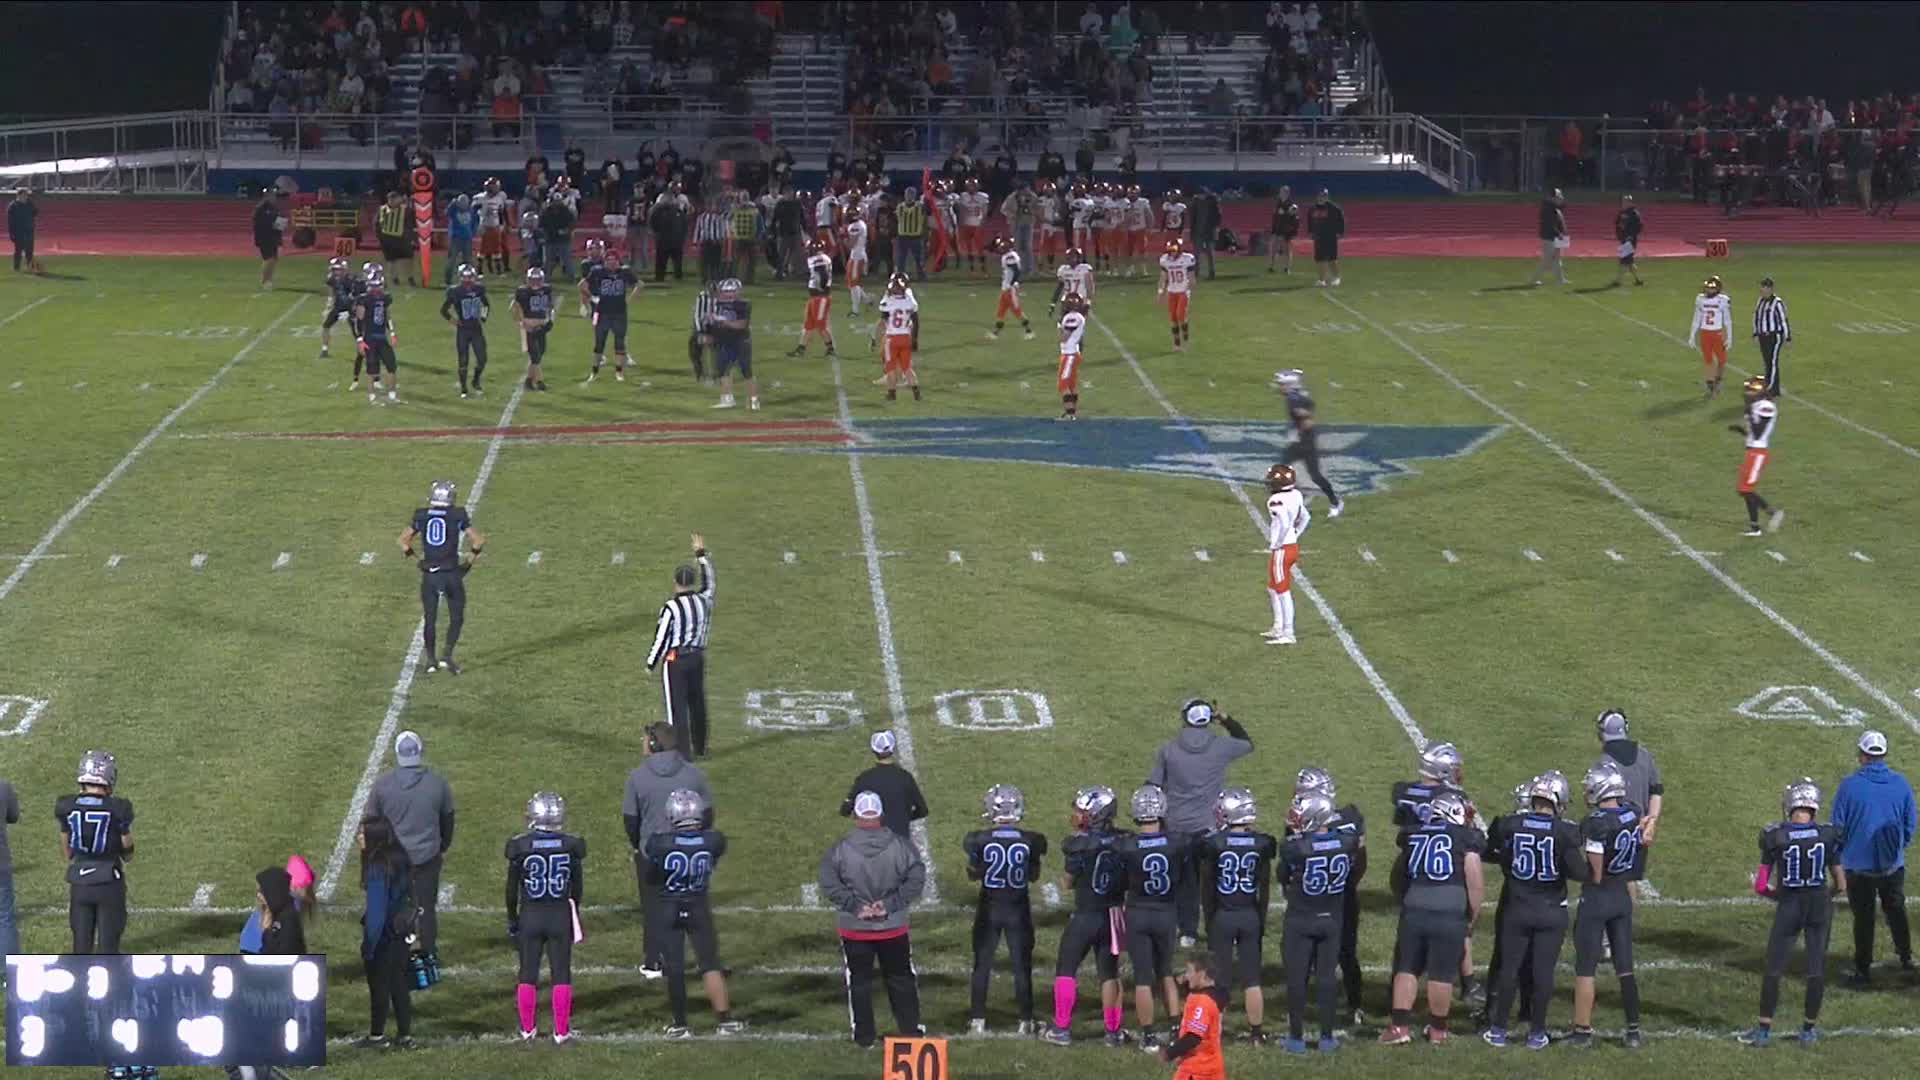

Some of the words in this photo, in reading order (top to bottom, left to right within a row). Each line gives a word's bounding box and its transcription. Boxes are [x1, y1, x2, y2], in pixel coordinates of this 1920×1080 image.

[1710, 241, 1727, 257] 30
[1705, 310, 1715, 326] 2
[426, 517, 446, 546] 0
[67, 811, 111, 853] 17
[523, 854, 570, 897] 35
[983, 843, 1030, 888] 28
[1142, 853, 1171, 895] 3
[1303, 854, 1351, 895] 52
[1408, 834, 1453, 880] 76
[1511, 834, 1560, 880] 51
[1782, 842, 1824, 887] 11
[892, 1041, 940, 1080] 50
